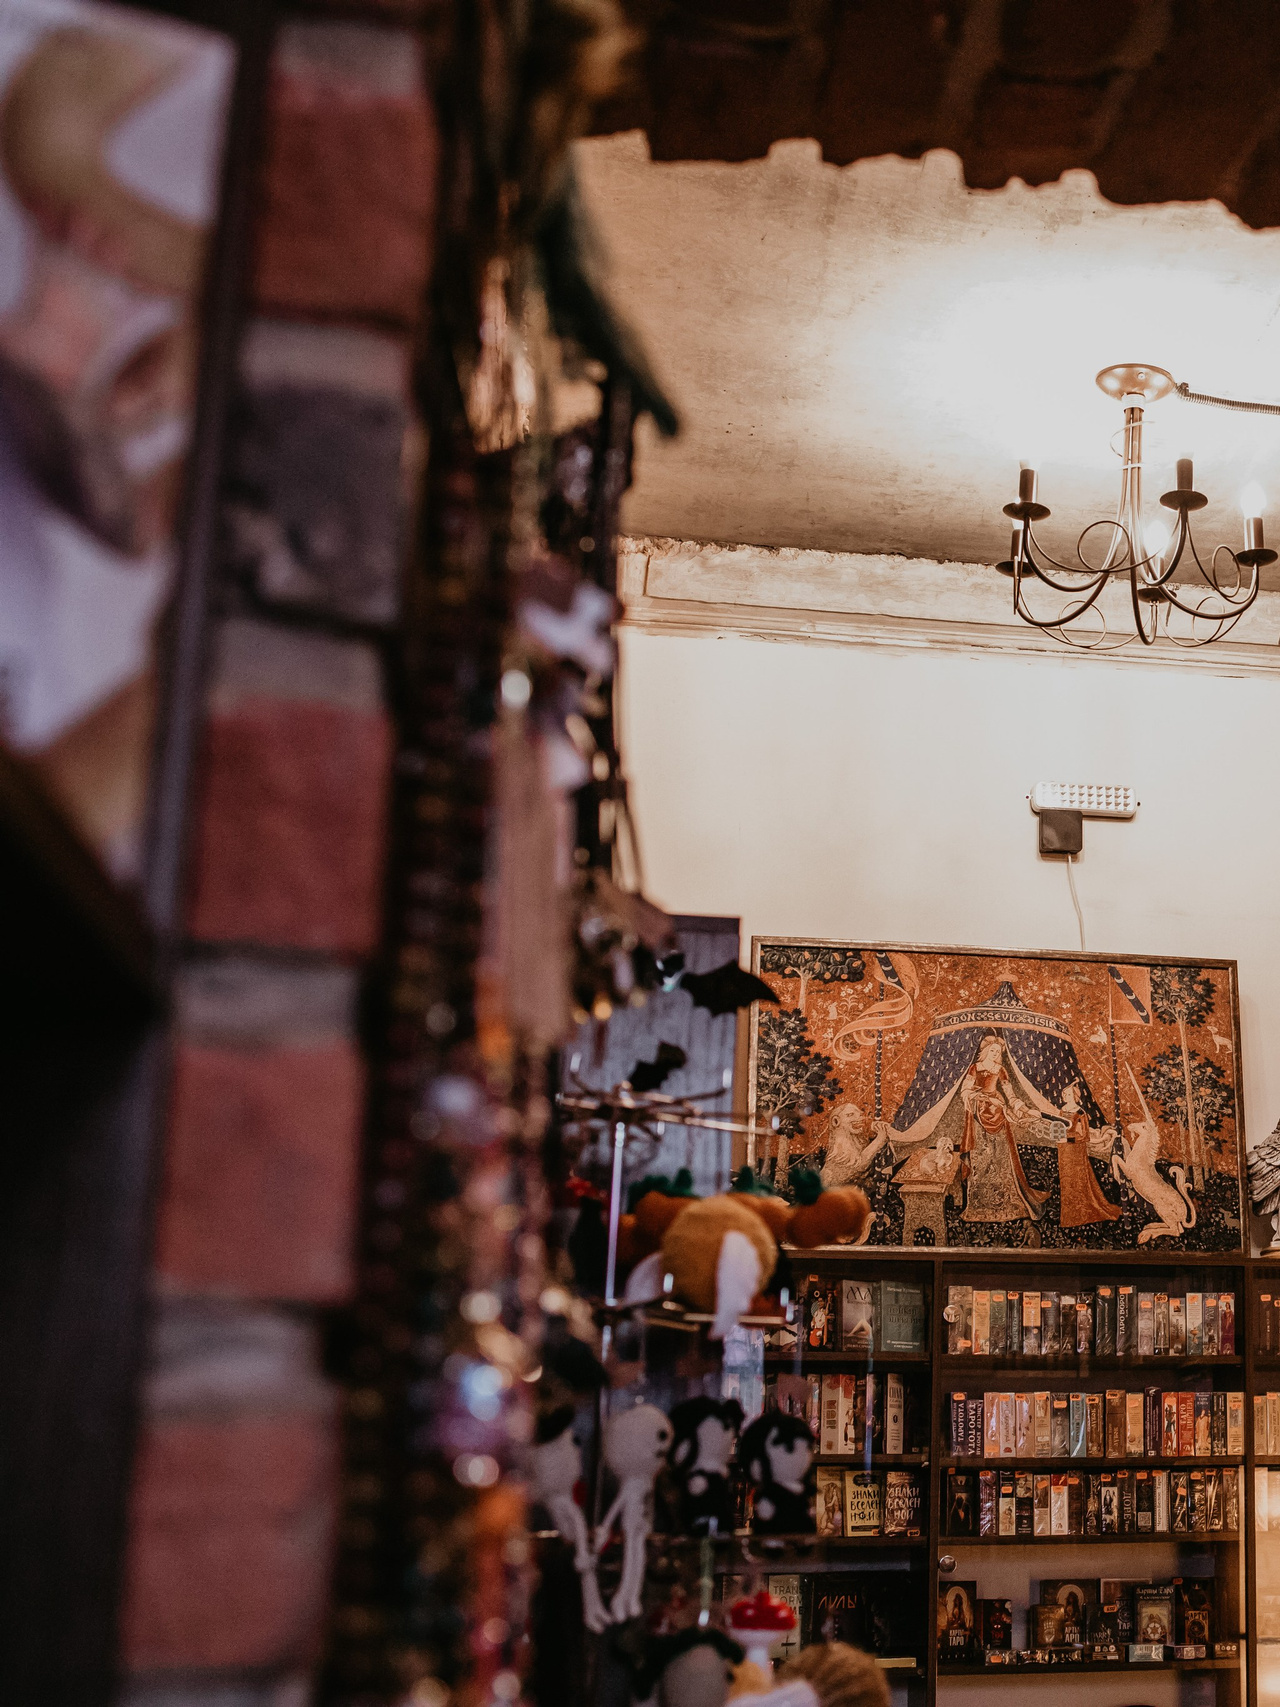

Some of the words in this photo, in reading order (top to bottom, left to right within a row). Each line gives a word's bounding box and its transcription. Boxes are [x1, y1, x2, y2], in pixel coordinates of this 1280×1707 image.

[968, 1403, 976, 1428] ТАРО
[968, 1429, 976, 1455] ТОТА
[852, 1489, 879, 1500] ЗНАКИ
[949, 1636, 964, 1647] ТАРО
[1064, 1634, 1080, 1644] АРО
